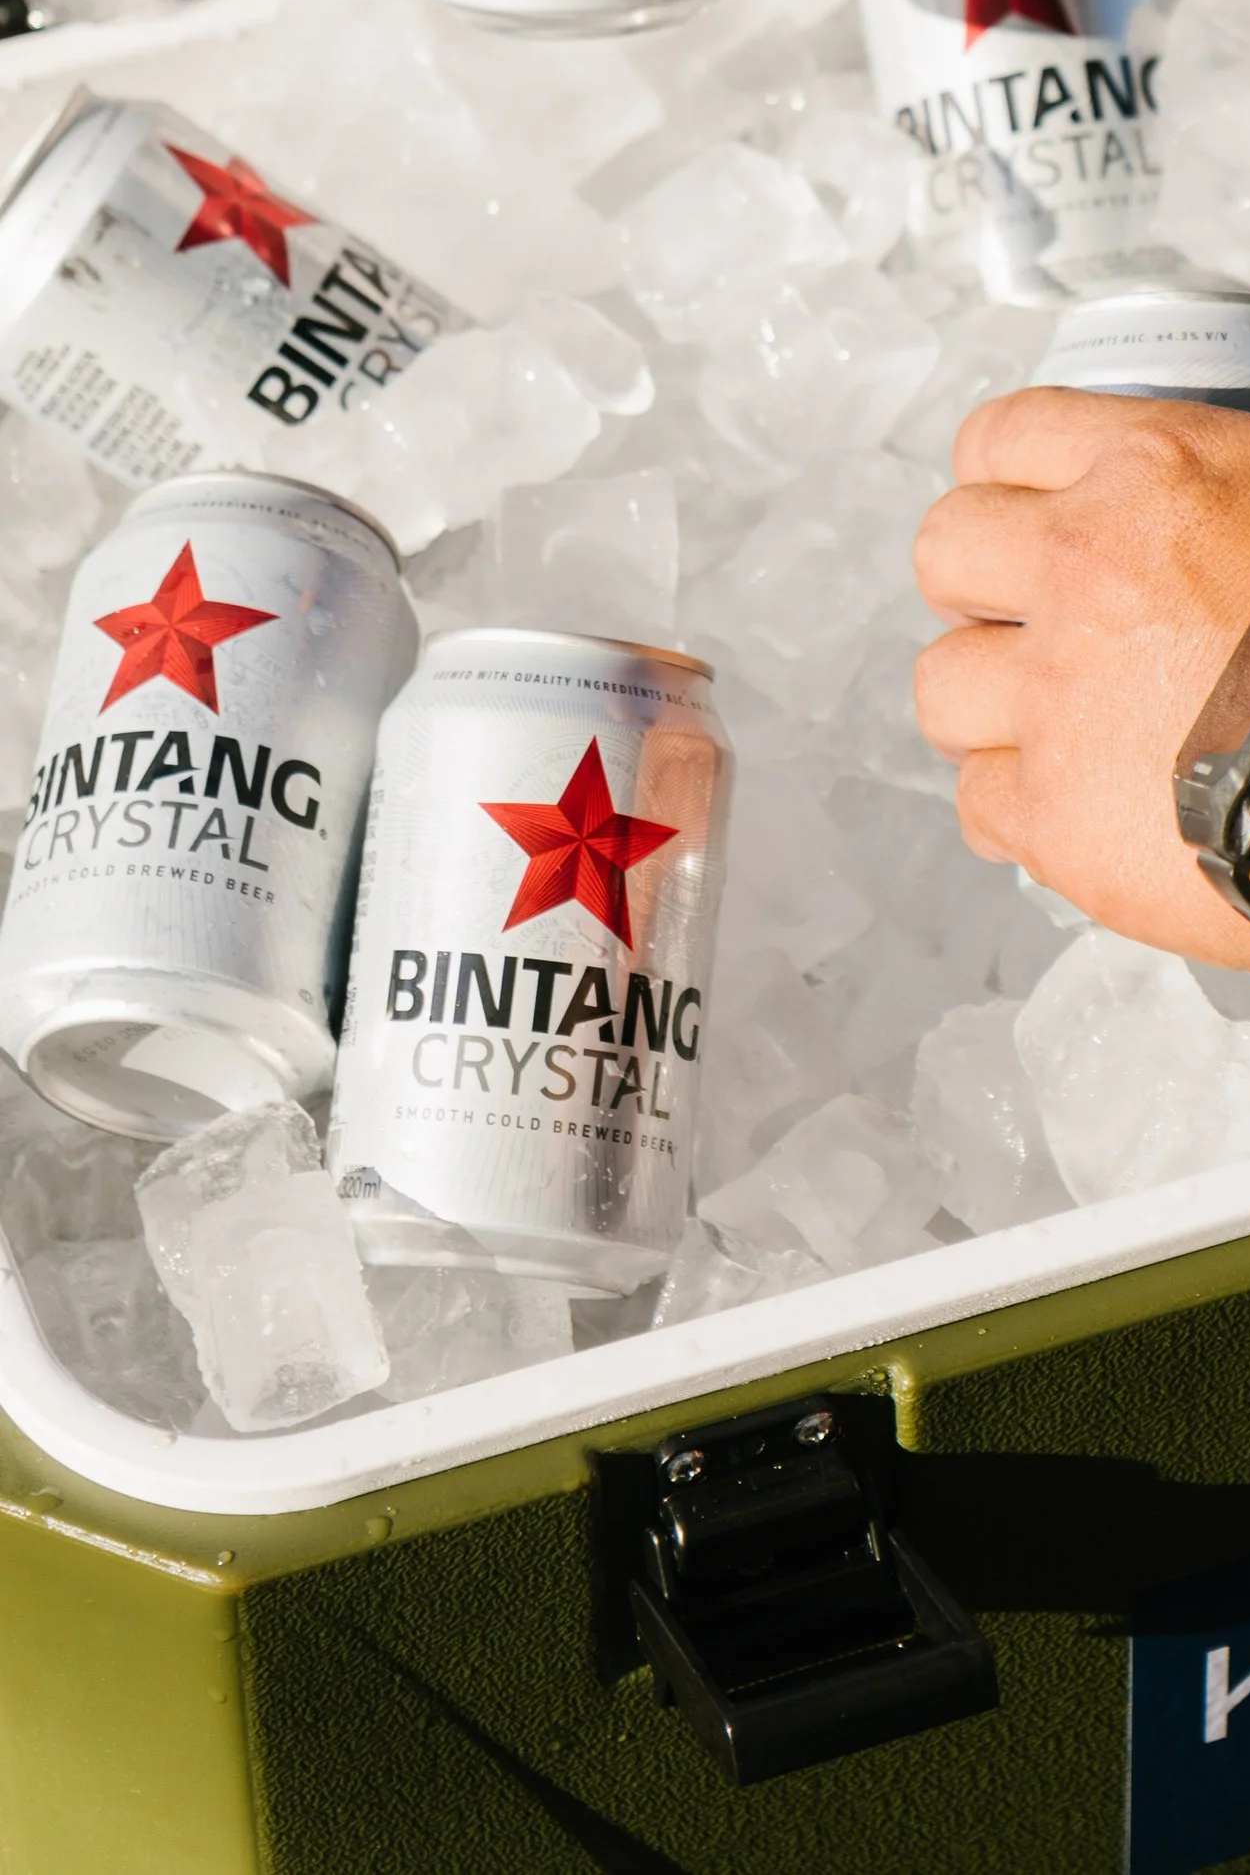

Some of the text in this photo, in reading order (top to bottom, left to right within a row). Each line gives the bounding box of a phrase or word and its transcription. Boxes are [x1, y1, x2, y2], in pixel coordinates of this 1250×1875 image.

[247, 245, 400, 426] BINTA
[477, 671, 509, 681] WITH
[514, 673, 571, 687] QUALITY
[577, 679, 662, 701] INGREDIENTS
[24, 800, 270, 873] CRYSTAL
[68, 865, 115, 879] COLD
[127, 864, 215, 885] BREWED
[226, 878, 276, 905] BEER
[386, 949, 702, 1062] BINTANG
[412, 1033, 670, 1120] CRYSTAL
[395, 1106, 675, 1155] SMOOTH COLD BREWED BEER
